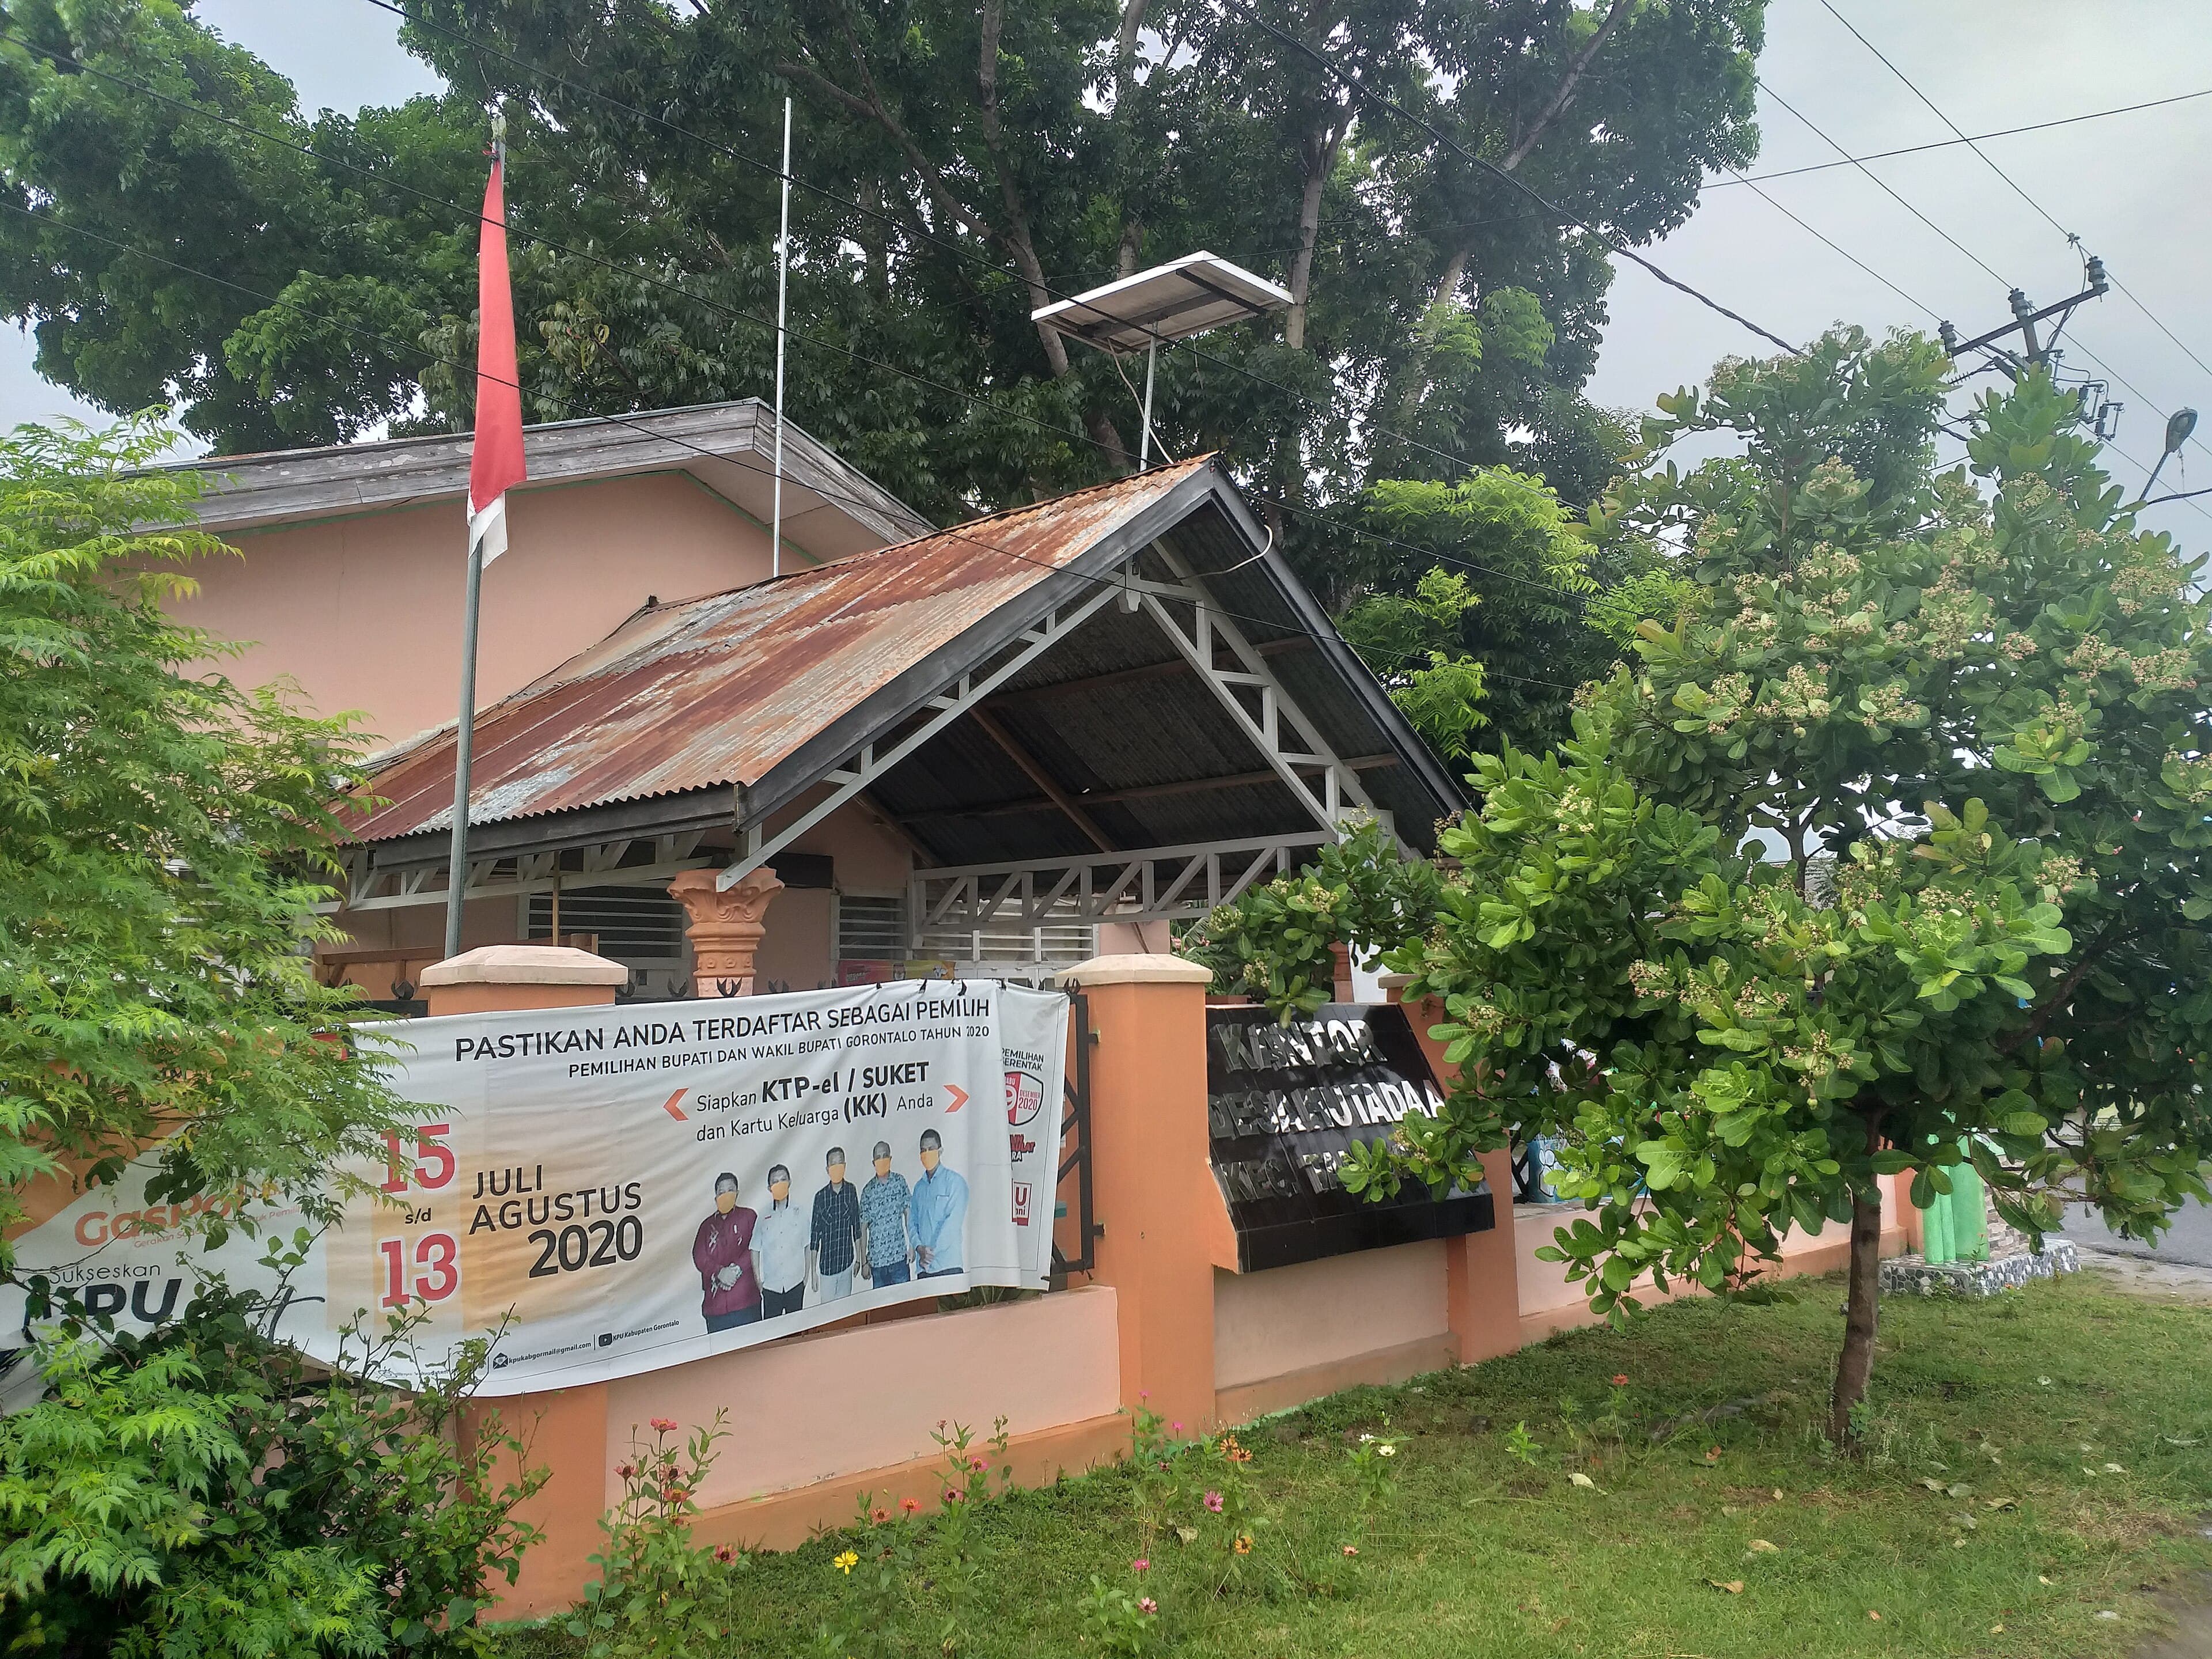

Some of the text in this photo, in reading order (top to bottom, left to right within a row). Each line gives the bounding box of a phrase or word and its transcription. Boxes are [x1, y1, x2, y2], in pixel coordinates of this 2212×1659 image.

[455, 998, 990, 1062] PASTIKAN ANDA TERDAFTAR SEBAGAI PEMILIH
[569, 1025, 990, 1078] PEMILIHAN BUPATI DAN WAKIL BUPATI GORONTALO TAHUN 2020
[1212, 1018, 1388, 1073] KANTOR
[696, 1091, 756, 1114] Siapkan
[762, 1071, 840, 1103] KTP-el
[862, 1061, 930, 1089] SUKET
[1006, 1075, 1016, 1086] ABU
[1018, 1097, 1037, 1111] 2020
[696, 1092, 934, 1142] dan Kartu Keluarga (KK) Anda
[380, 1123, 456, 1194] 15
[472, 1164, 543, 1199] JULI
[404, 1207, 431, 1225] s/d
[468, 1181, 642, 1236] AGUSTUS
[50, 1263, 161, 1284] Sukseskan
[381, 1233, 458, 1309] 13
[528, 1215, 643, 1279] 2020
[612, 1319, 680, 1342] KPU Kabupaten Gorontalo
